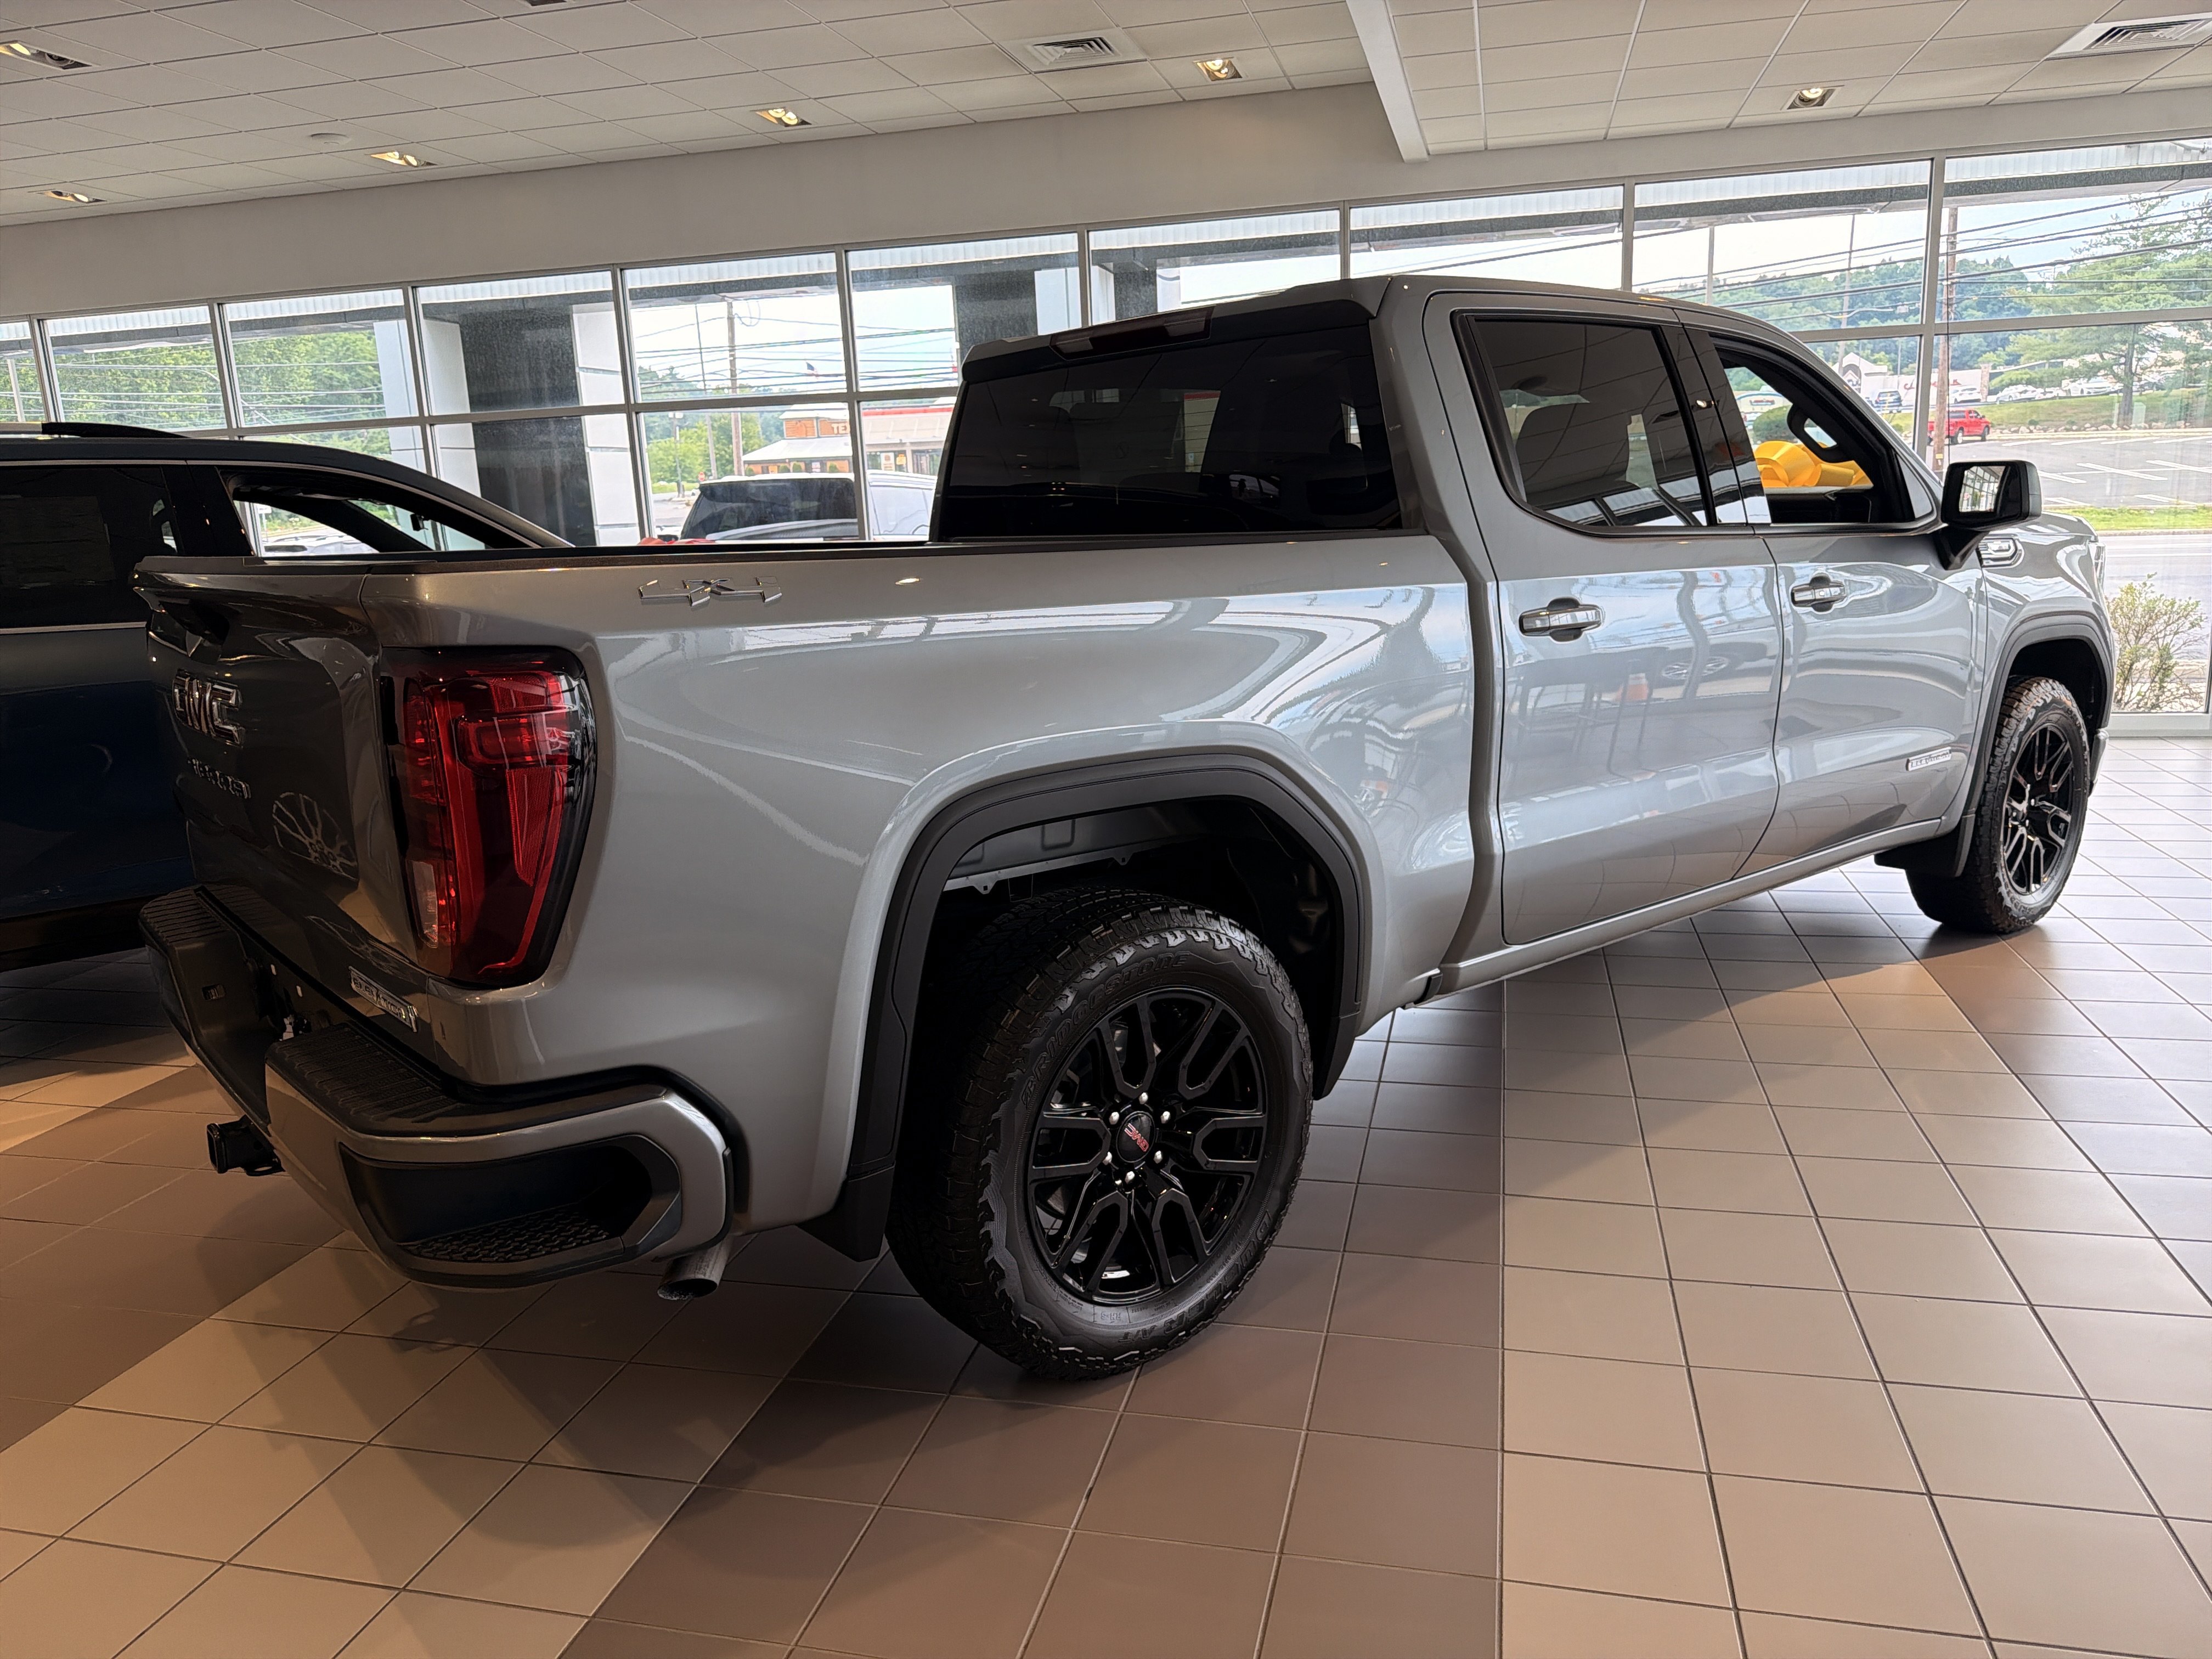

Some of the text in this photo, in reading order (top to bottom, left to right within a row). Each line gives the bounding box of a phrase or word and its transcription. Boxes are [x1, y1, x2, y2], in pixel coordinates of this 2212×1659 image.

[173, 669, 246, 748] GMC
[1020, 950, 1190, 1108] BRIDGESTONE
[1124, 1122, 1150, 1152] GMC
